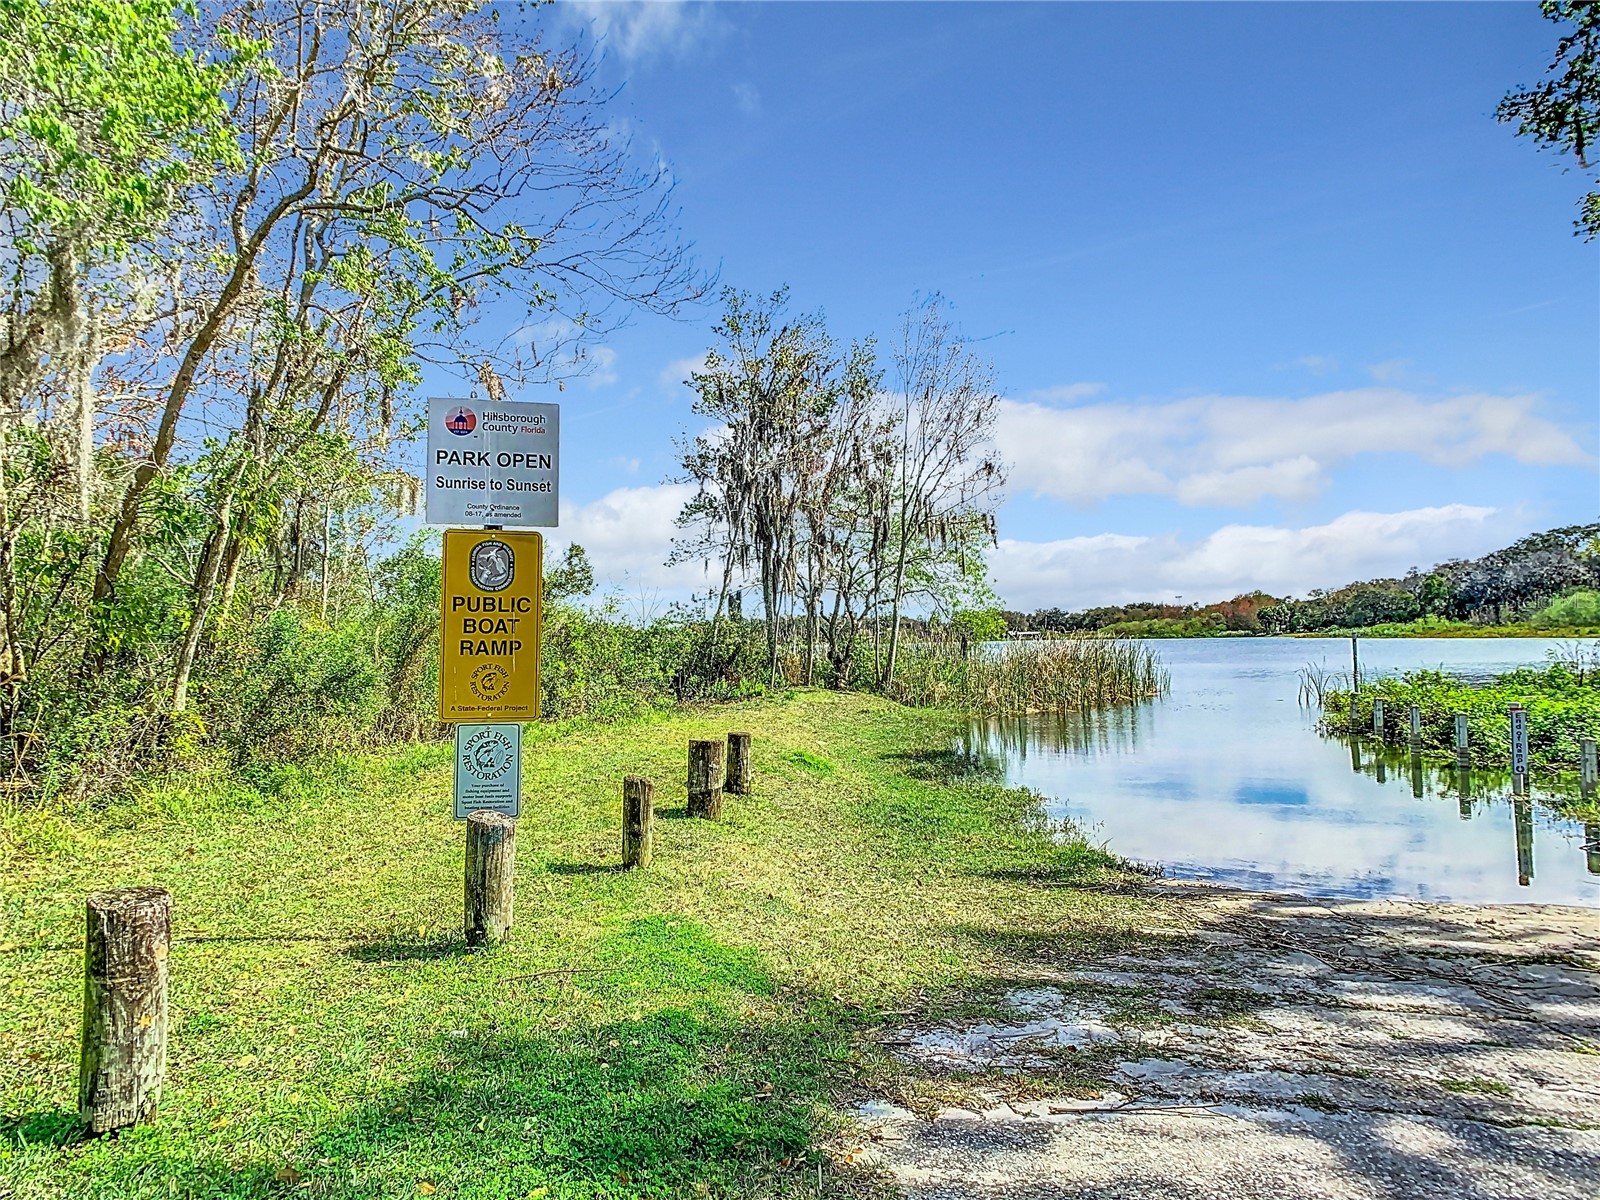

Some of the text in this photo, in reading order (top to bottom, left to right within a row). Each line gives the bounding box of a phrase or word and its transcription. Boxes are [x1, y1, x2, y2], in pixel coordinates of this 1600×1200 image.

[482, 412, 546, 426] Hillsborough
[482, 422, 546, 434] County Florida
[436, 450, 552, 469] PARK OPEN
[436, 476, 551, 492] Sunrise to Sunset
[466, 503, 488, 511] County
[452, 596, 531, 613] PUBLIC
[463, 618, 520, 634] BOAT
[460, 640, 522, 656] RAMP
[471, 664, 509, 680] SPORT FISH
[470, 681, 510, 701] RESTORATION
[464, 730, 513, 751] SPORT FISH
[1516, 730, 1522, 741] of
[462, 754, 514, 780] RESTORATION
